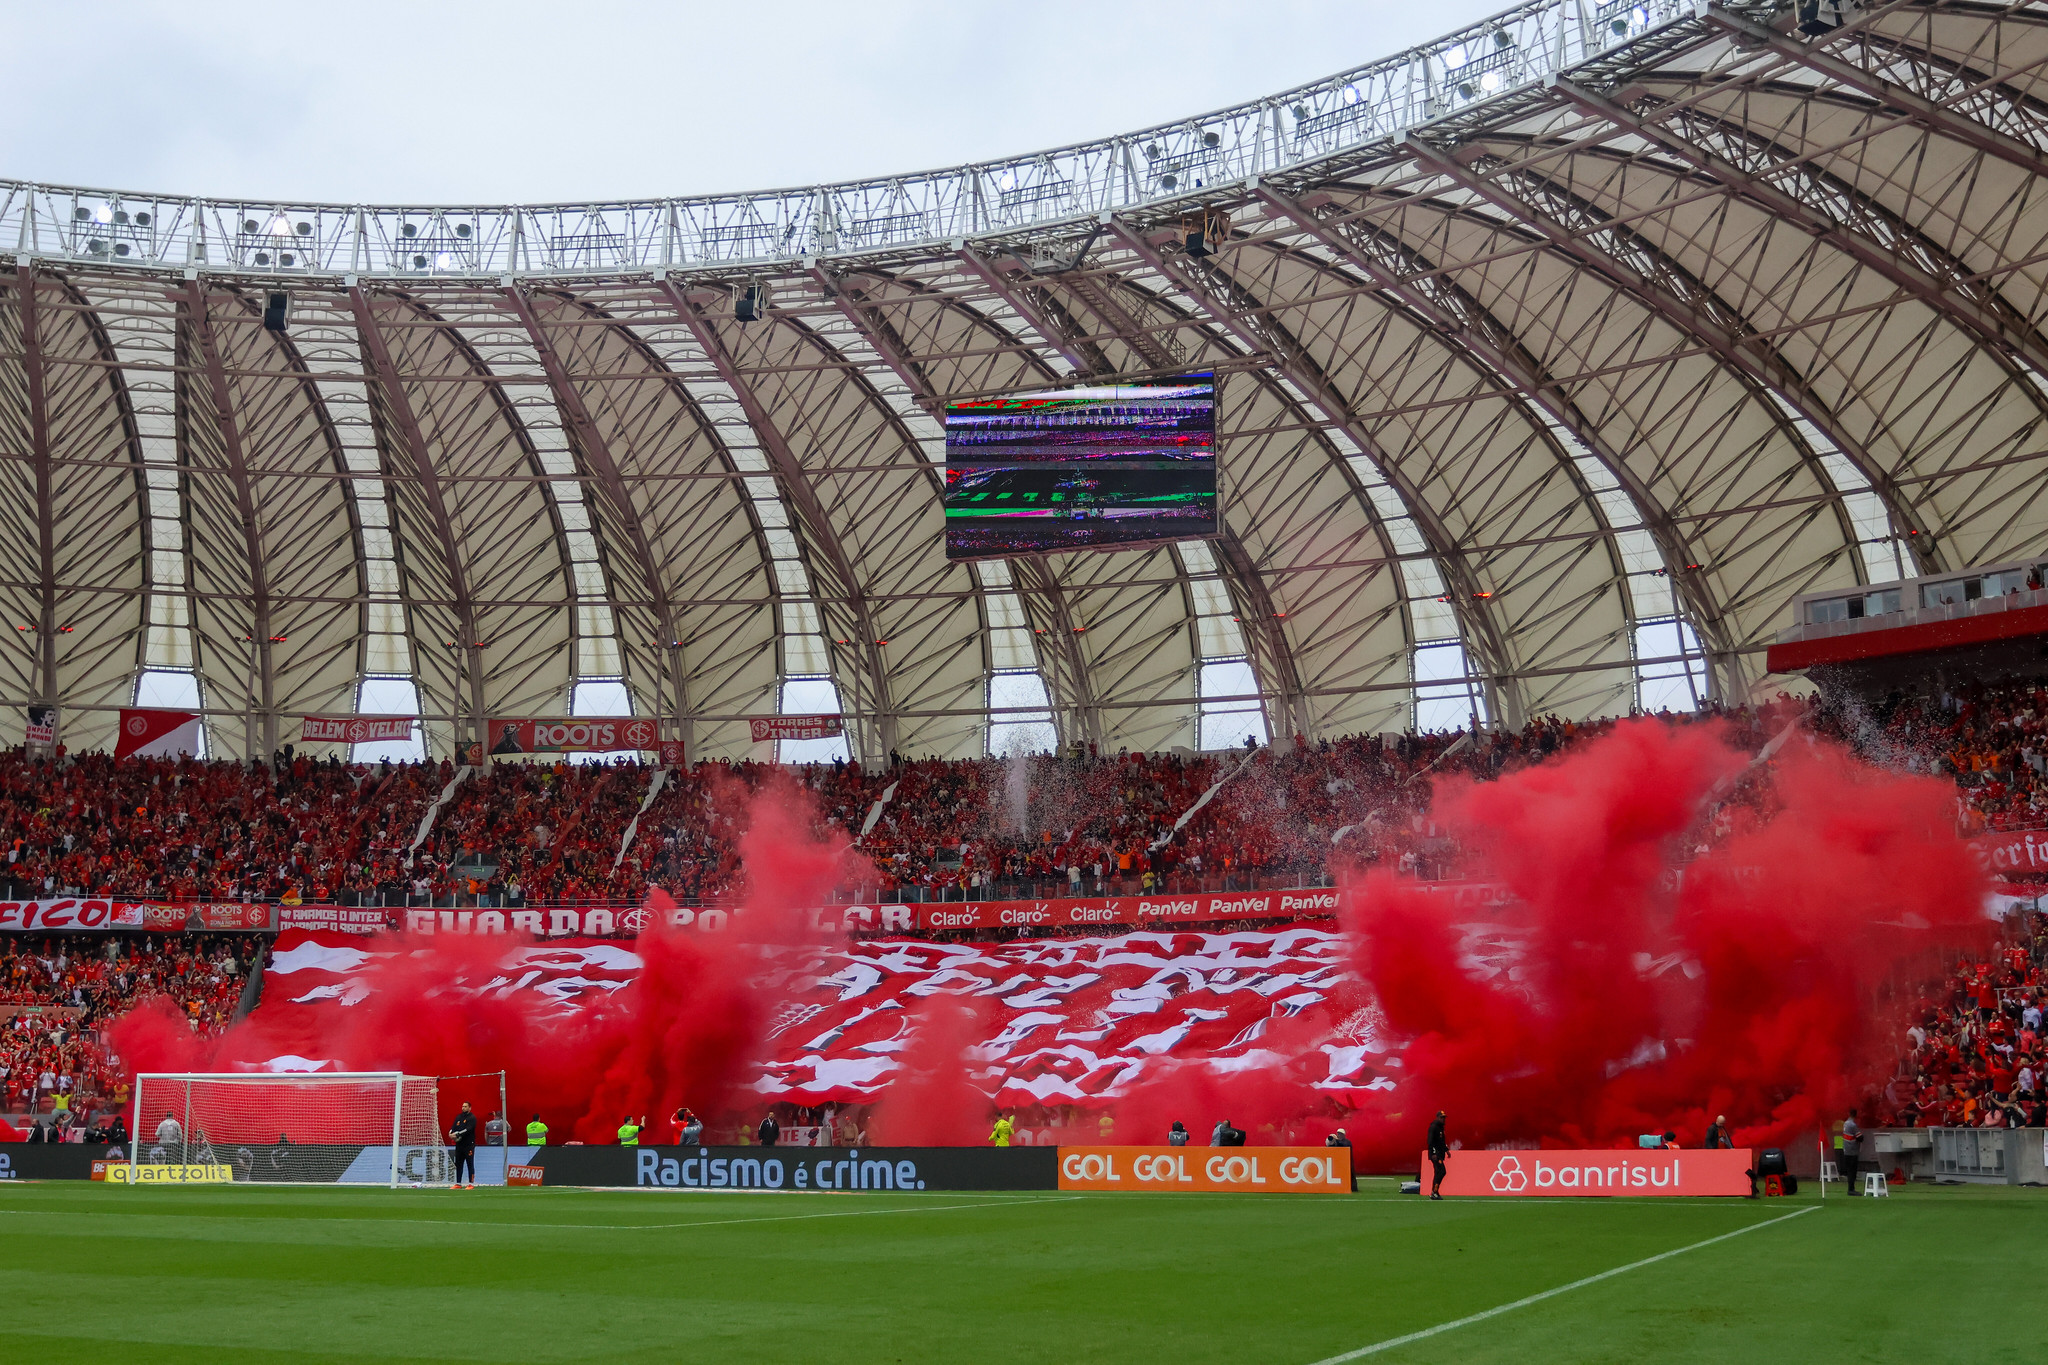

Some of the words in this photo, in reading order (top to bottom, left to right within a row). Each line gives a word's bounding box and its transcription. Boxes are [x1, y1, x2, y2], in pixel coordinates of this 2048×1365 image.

[304, 720, 346, 739] BELÉM
[368, 720, 411, 738] VELHO
[534, 724, 615, 746] ROOTS
[769, 727, 822, 739] INTER
[210, 905, 242, 915] ROOTS
[1138, 900, 1198, 916] PanVel
[1209, 897, 1270, 913] PanVel
[1280, 893, 1341, 910] PanVel
[144, 906, 186, 920] ROOTS
[349, 911, 382, 923] INTER
[930, 910, 975, 926] Claro
[1000, 908, 1045, 924] Claro
[1070, 906, 1115, 922] Claro
[406, 908, 616, 936] GUARDA
[113, 1165, 226, 1183] quartzolit
[509, 1166, 544, 1179] BETANO
[637, 1148, 784, 1188] Racismo
[794, 1162, 808, 1187] é
[815, 1150, 925, 1190] crime.
[1063, 1154, 1120, 1180] GOL
[1133, 1155, 1192, 1181] GOL
[1205, 1156, 1266, 1183] GOL
[1280, 1157, 1341, 1184] GOL
[1535, 1159, 1679, 1187] banrisul
